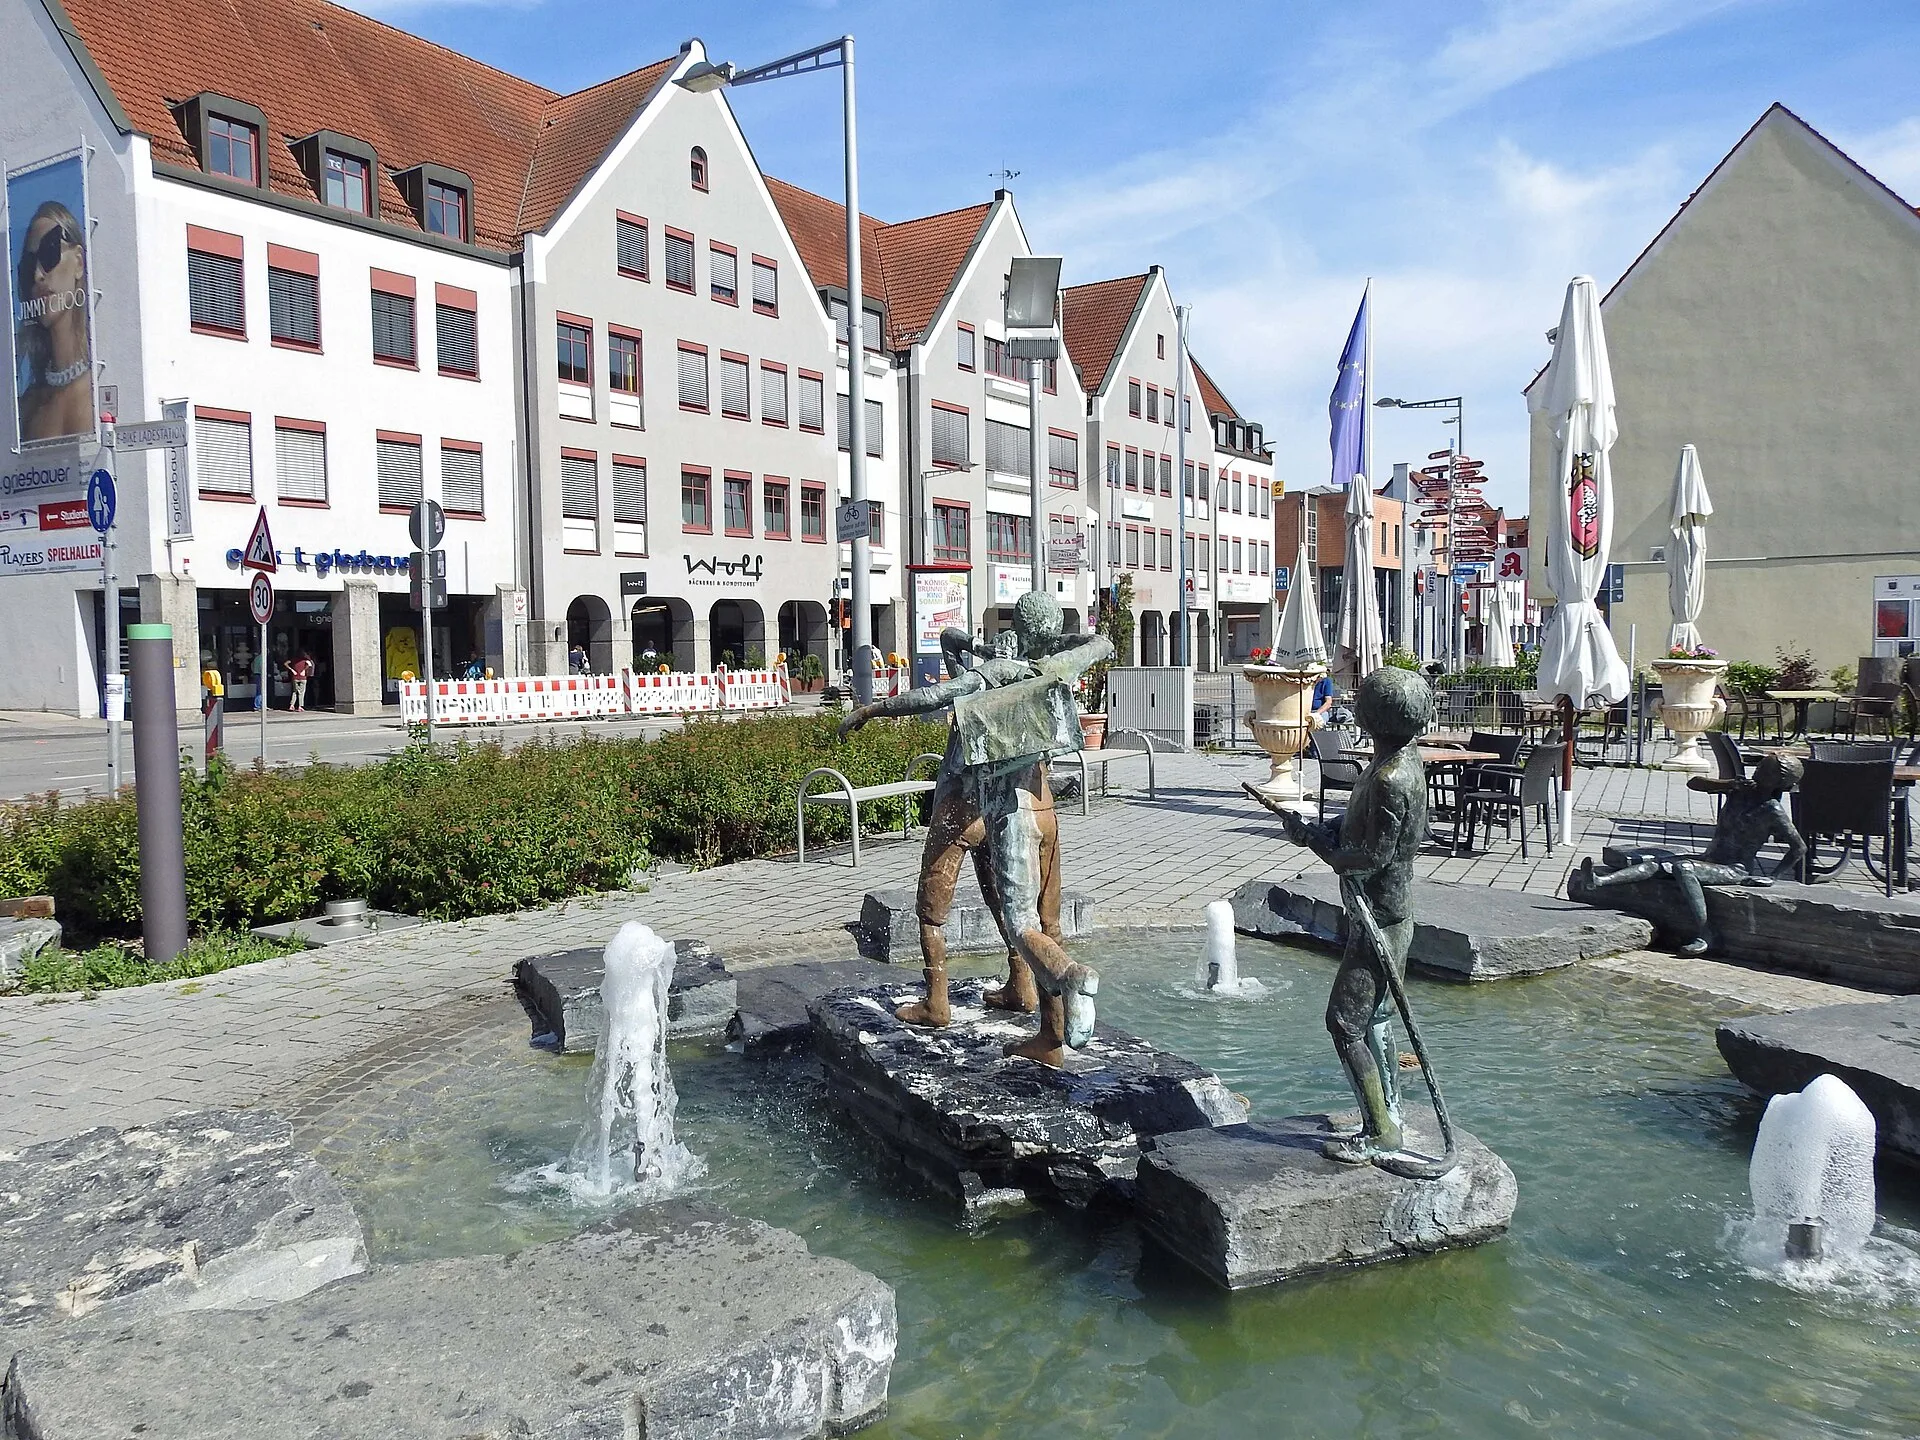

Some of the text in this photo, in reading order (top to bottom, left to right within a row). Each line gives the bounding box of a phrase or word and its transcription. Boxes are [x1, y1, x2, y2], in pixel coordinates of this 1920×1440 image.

[18, 288, 86, 320] JIMMY CHOO
[138, 426, 185, 443] LADESTATION
[0, 543, 101, 567] PLAYERS SPIELHALLEN
[315, 549, 411, 572] griesbaue
[683, 553, 763, 582] Wolf
[1428, 570, 1436, 594] Stark
[255, 585, 269, 609] 30
